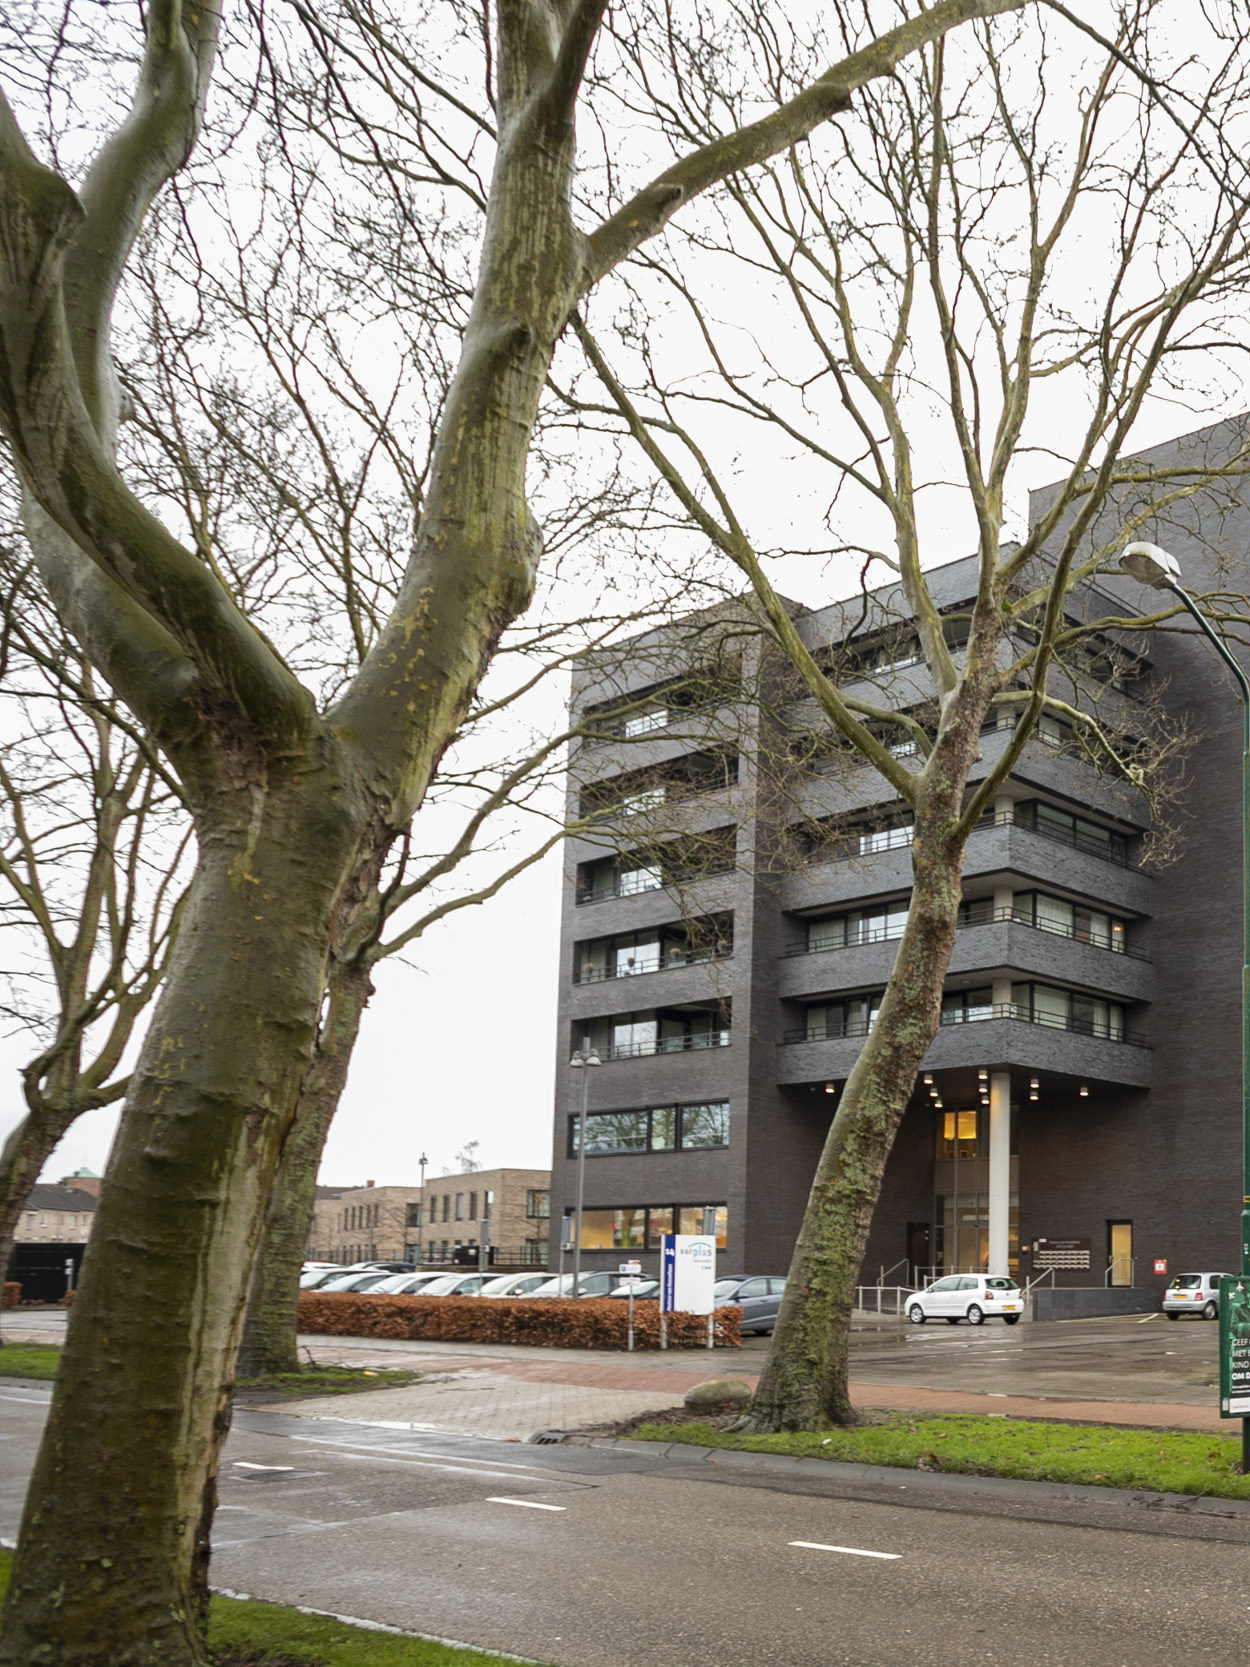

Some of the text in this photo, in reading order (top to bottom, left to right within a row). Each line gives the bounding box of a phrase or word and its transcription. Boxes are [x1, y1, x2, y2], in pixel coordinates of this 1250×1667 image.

[680, 1245, 712, 1258] surplus
[1231, 1338, 1248, 1346] GEEF
[1232, 1349, 1246, 1357] MET
